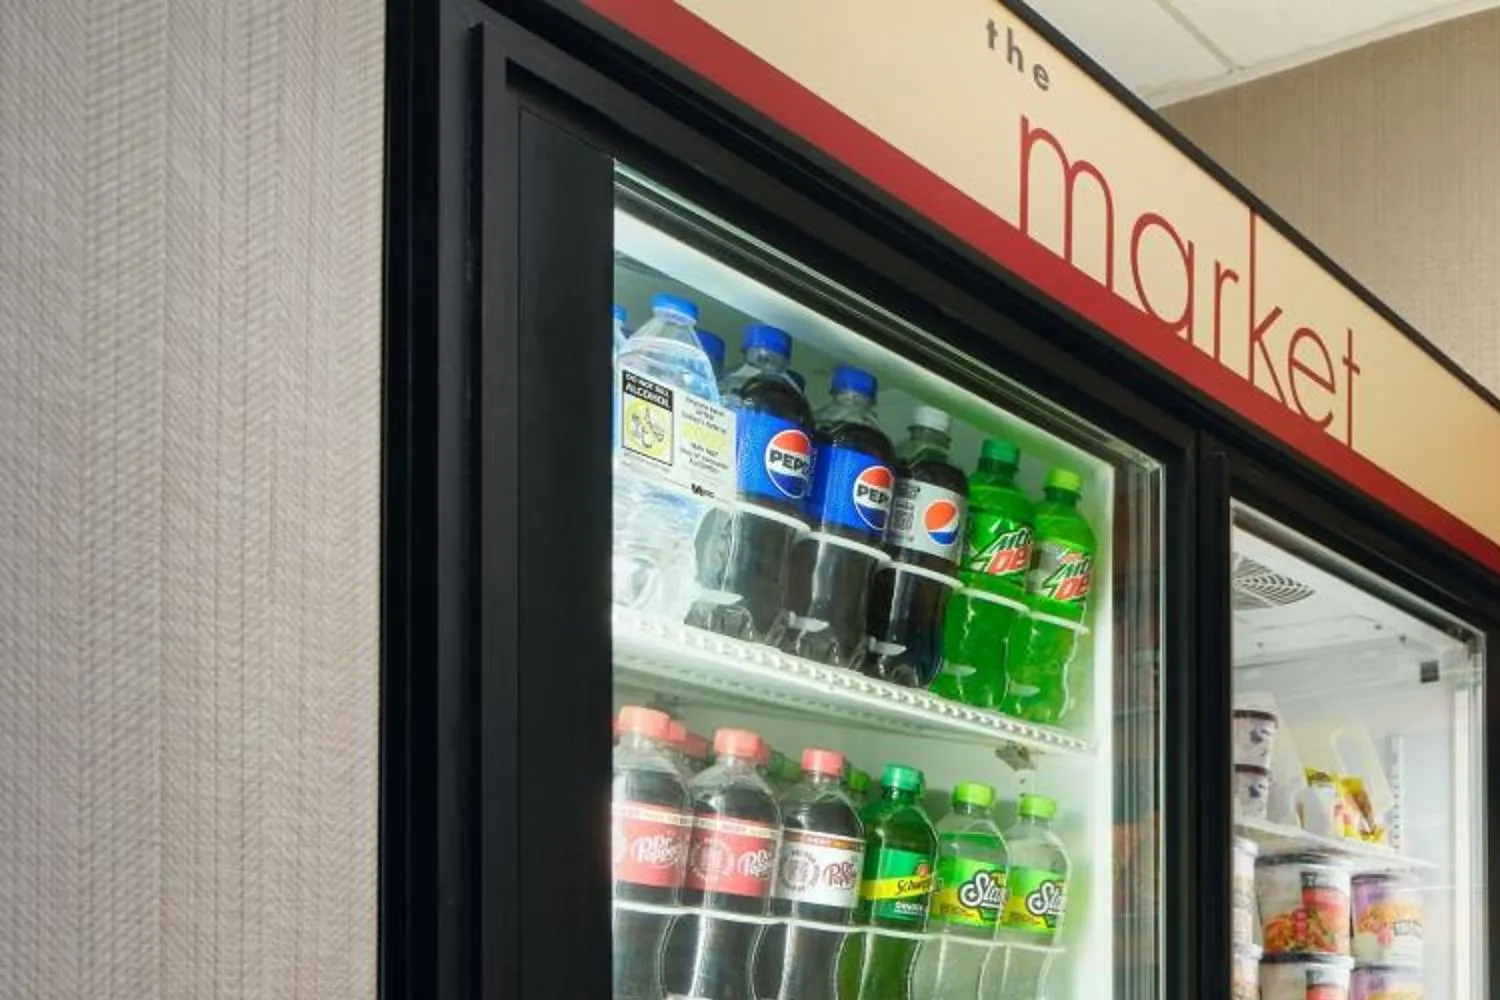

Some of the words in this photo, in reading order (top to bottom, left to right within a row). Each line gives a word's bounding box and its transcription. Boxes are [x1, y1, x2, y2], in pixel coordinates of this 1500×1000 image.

[986, 18, 1050, 91] the
[1020, 114, 1361, 450] market
[769, 449, 804, 471] PEP
[857, 484, 889, 504] PEP
